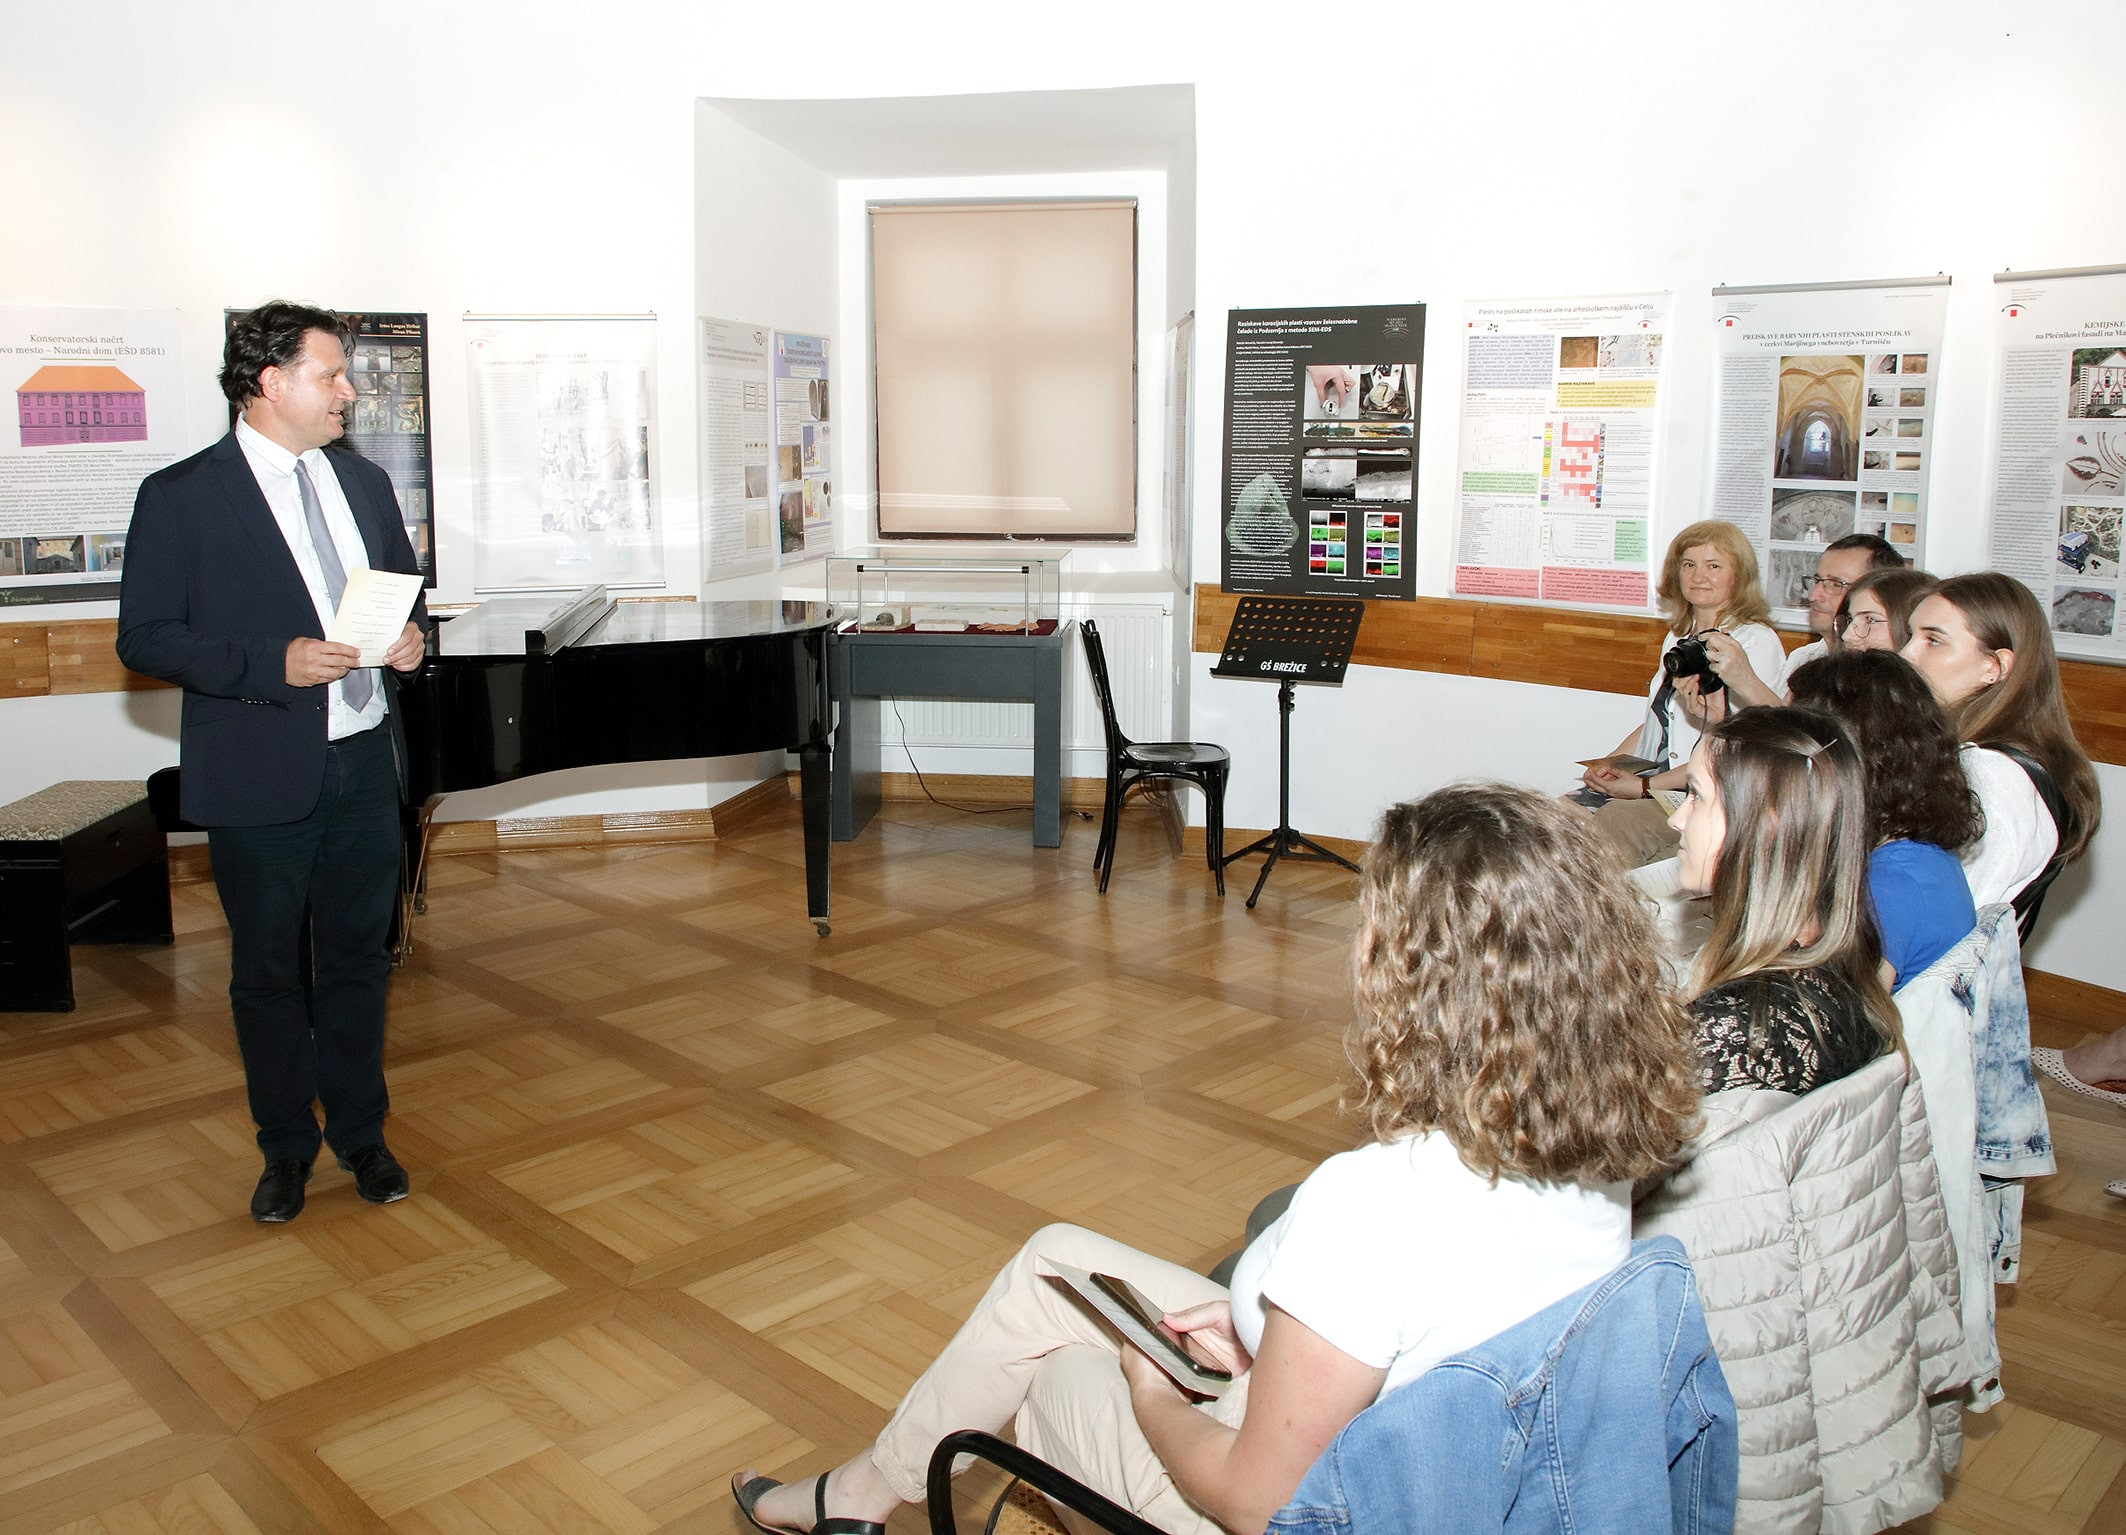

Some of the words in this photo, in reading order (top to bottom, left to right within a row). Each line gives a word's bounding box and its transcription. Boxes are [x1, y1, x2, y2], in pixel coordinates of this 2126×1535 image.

[2084, 320, 2125, 329] KEMIJSKE
[30, 335, 98, 343] Konservatorski
[101, 336, 124, 344] načrt
[2045, 331, 2080, 339] Plečnikovi
[54, 346, 90, 354] Narodni
[93, 347, 112, 355] dom
[114, 346, 137, 356] (EŠD
[140, 347, 166, 356] 8581)
[1260, 660, 1272, 670] GŠ
[1273, 661, 1308, 673] BREŽICE
